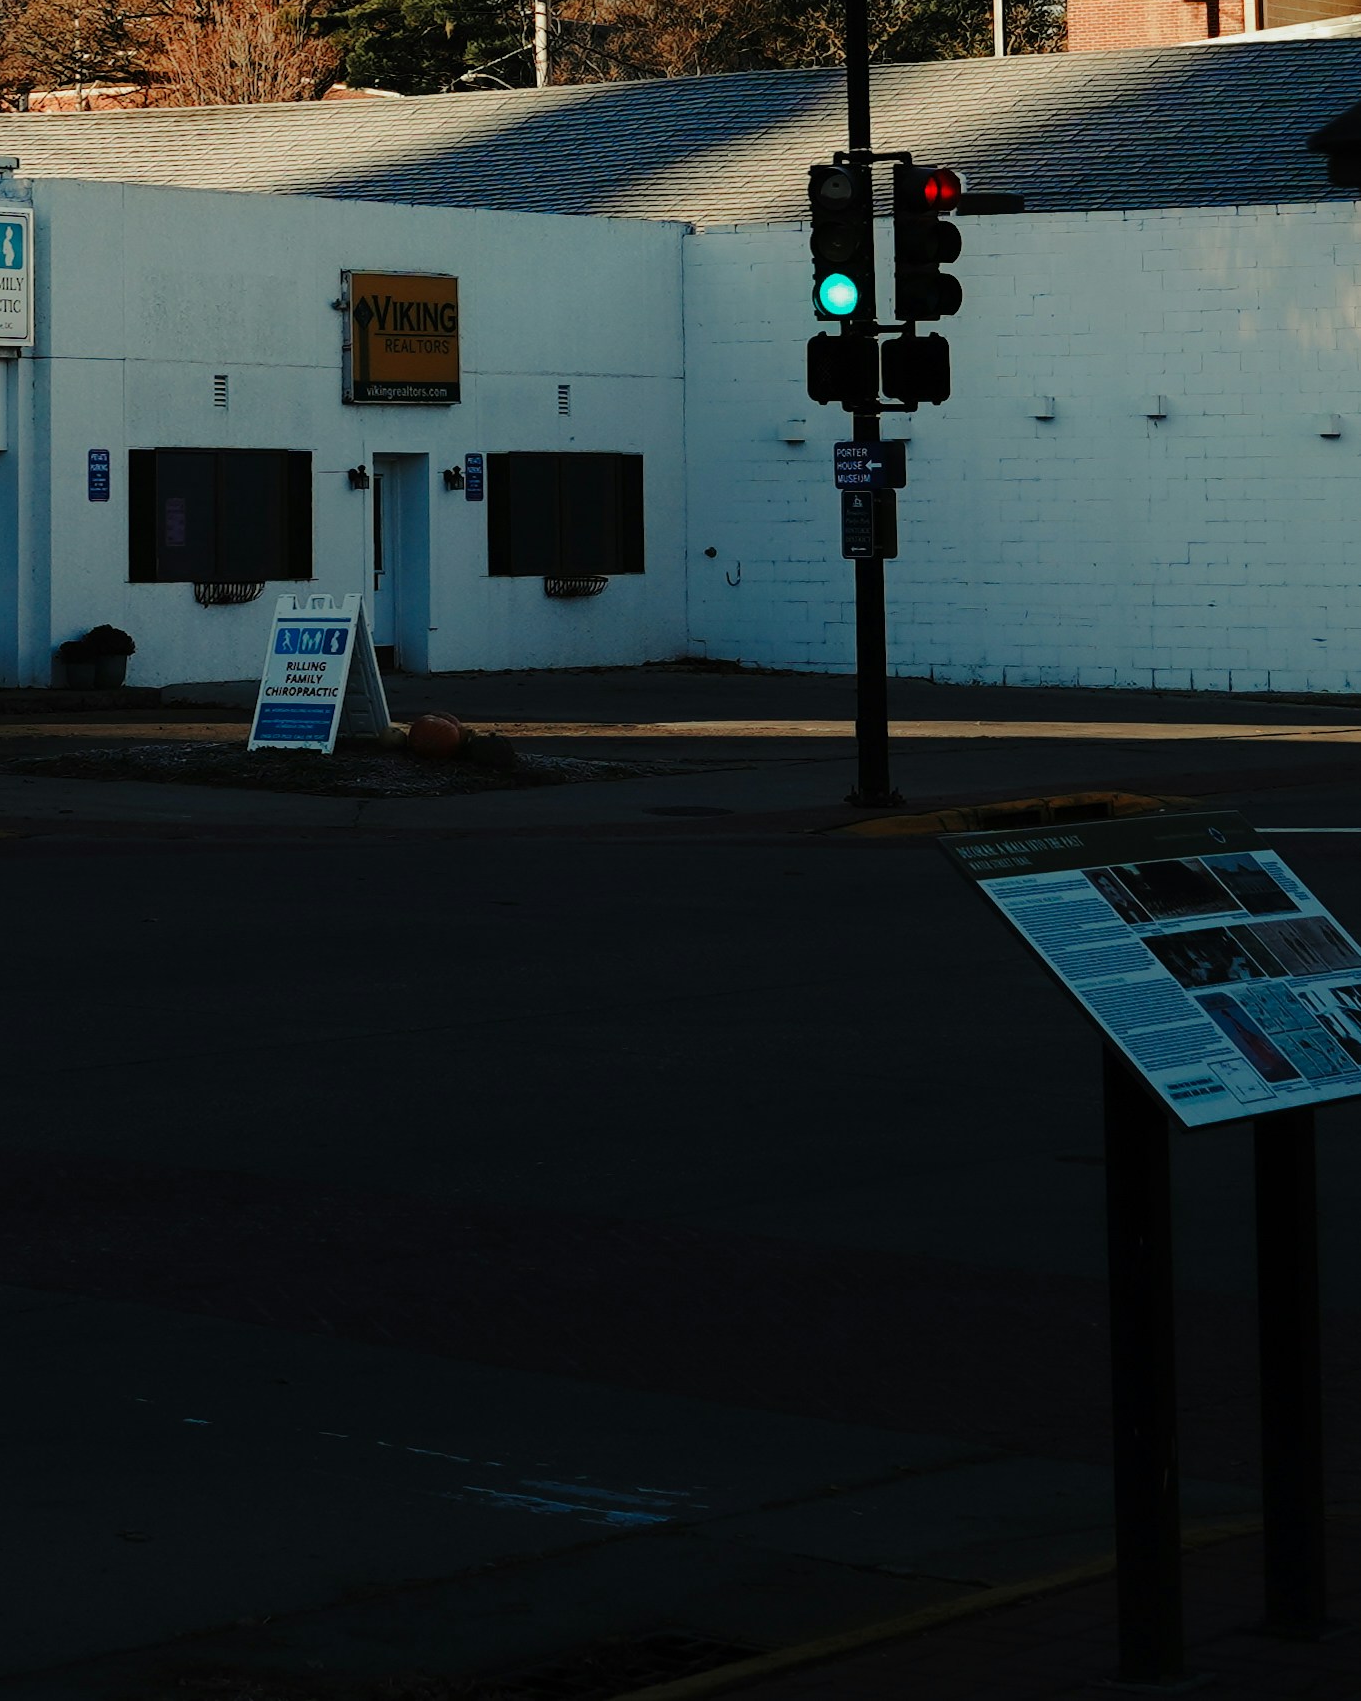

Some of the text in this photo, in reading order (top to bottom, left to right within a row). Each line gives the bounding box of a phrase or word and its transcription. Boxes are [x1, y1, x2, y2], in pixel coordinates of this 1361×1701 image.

[371, 295, 457, 333] VIKING
[385, 338, 449, 354] REALTORS
[366, 385, 447, 399] vikingrealtors.com
[836, 448, 868, 457] PORTER
[837, 460, 863, 470] HOUSE
[837, 474, 871, 483] MUSEUM
[286, 661, 327, 671] RILLING
[285, 674, 323, 684] FAMILY
[265, 686, 339, 697] CHIROPRACTIC
